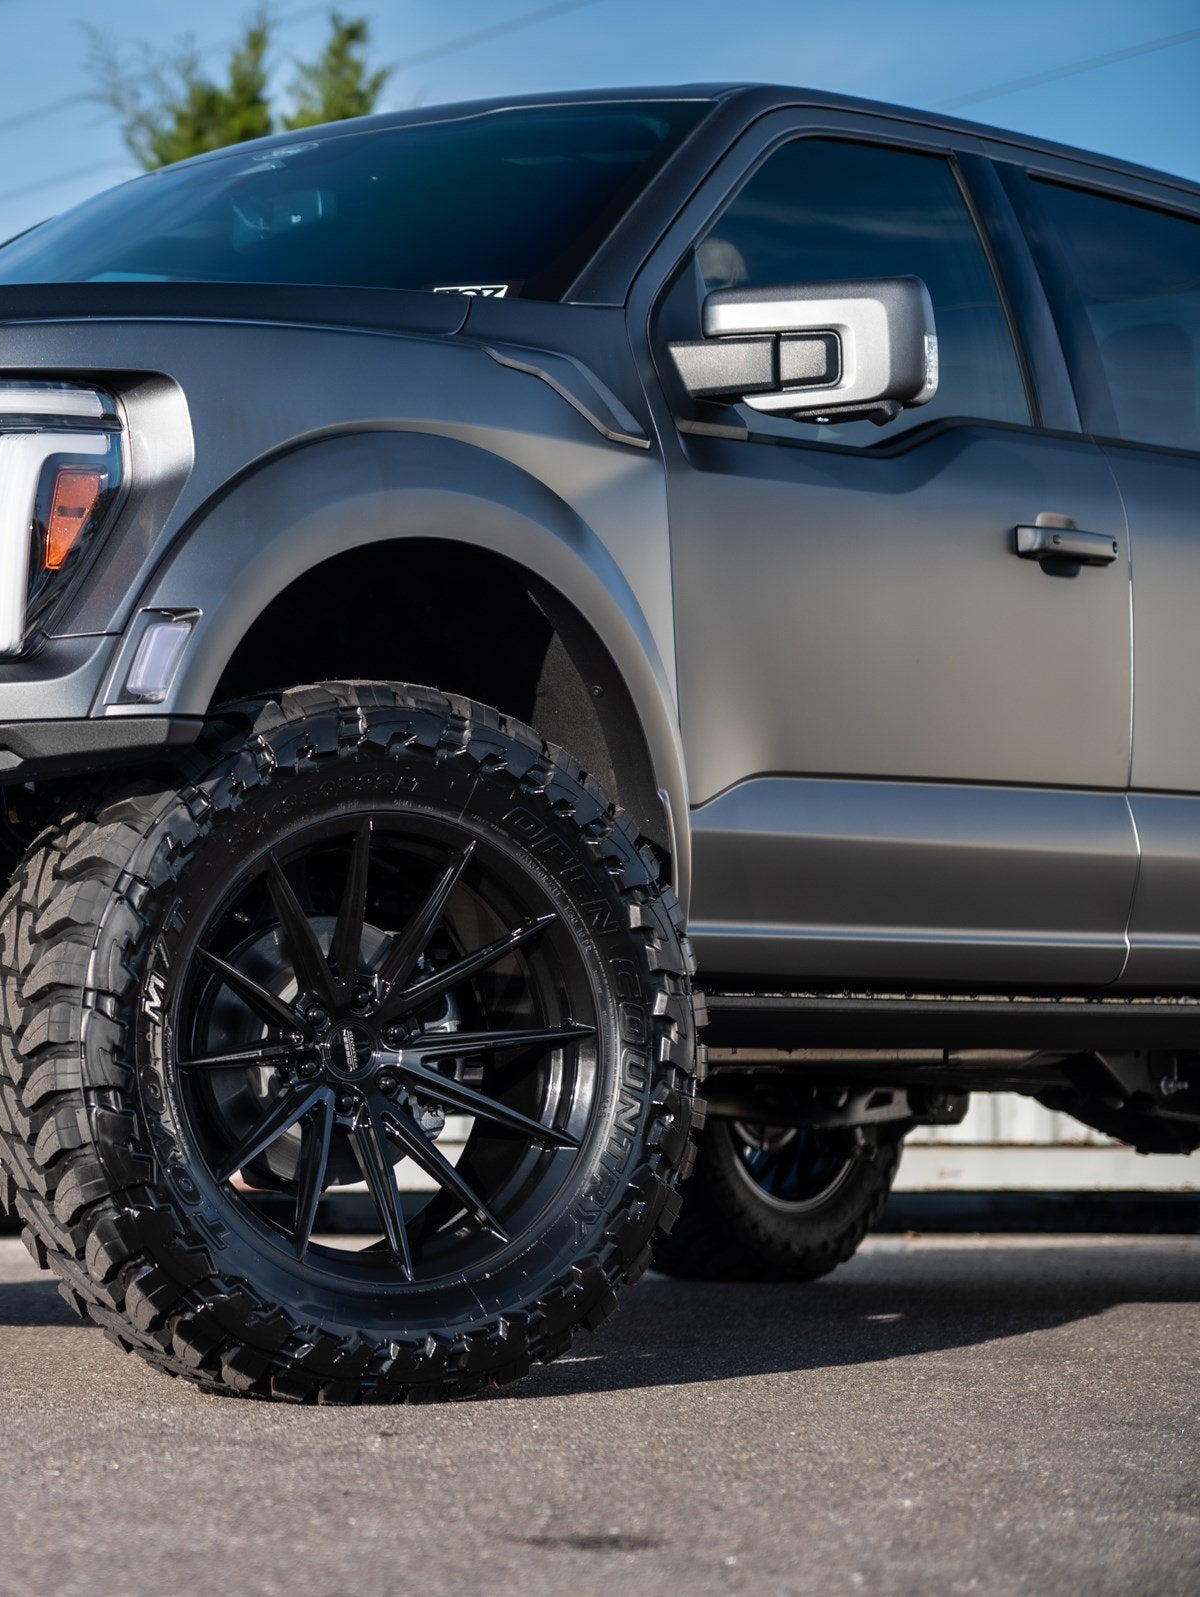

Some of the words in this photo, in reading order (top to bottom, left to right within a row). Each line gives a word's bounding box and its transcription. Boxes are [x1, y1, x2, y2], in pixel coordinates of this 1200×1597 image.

[142, 897, 187, 1026] M/T
[502, 806, 619, 934] OPEN
[569, 958, 648, 1235] COUNTRY
[140, 1064, 231, 1251] TOYO
